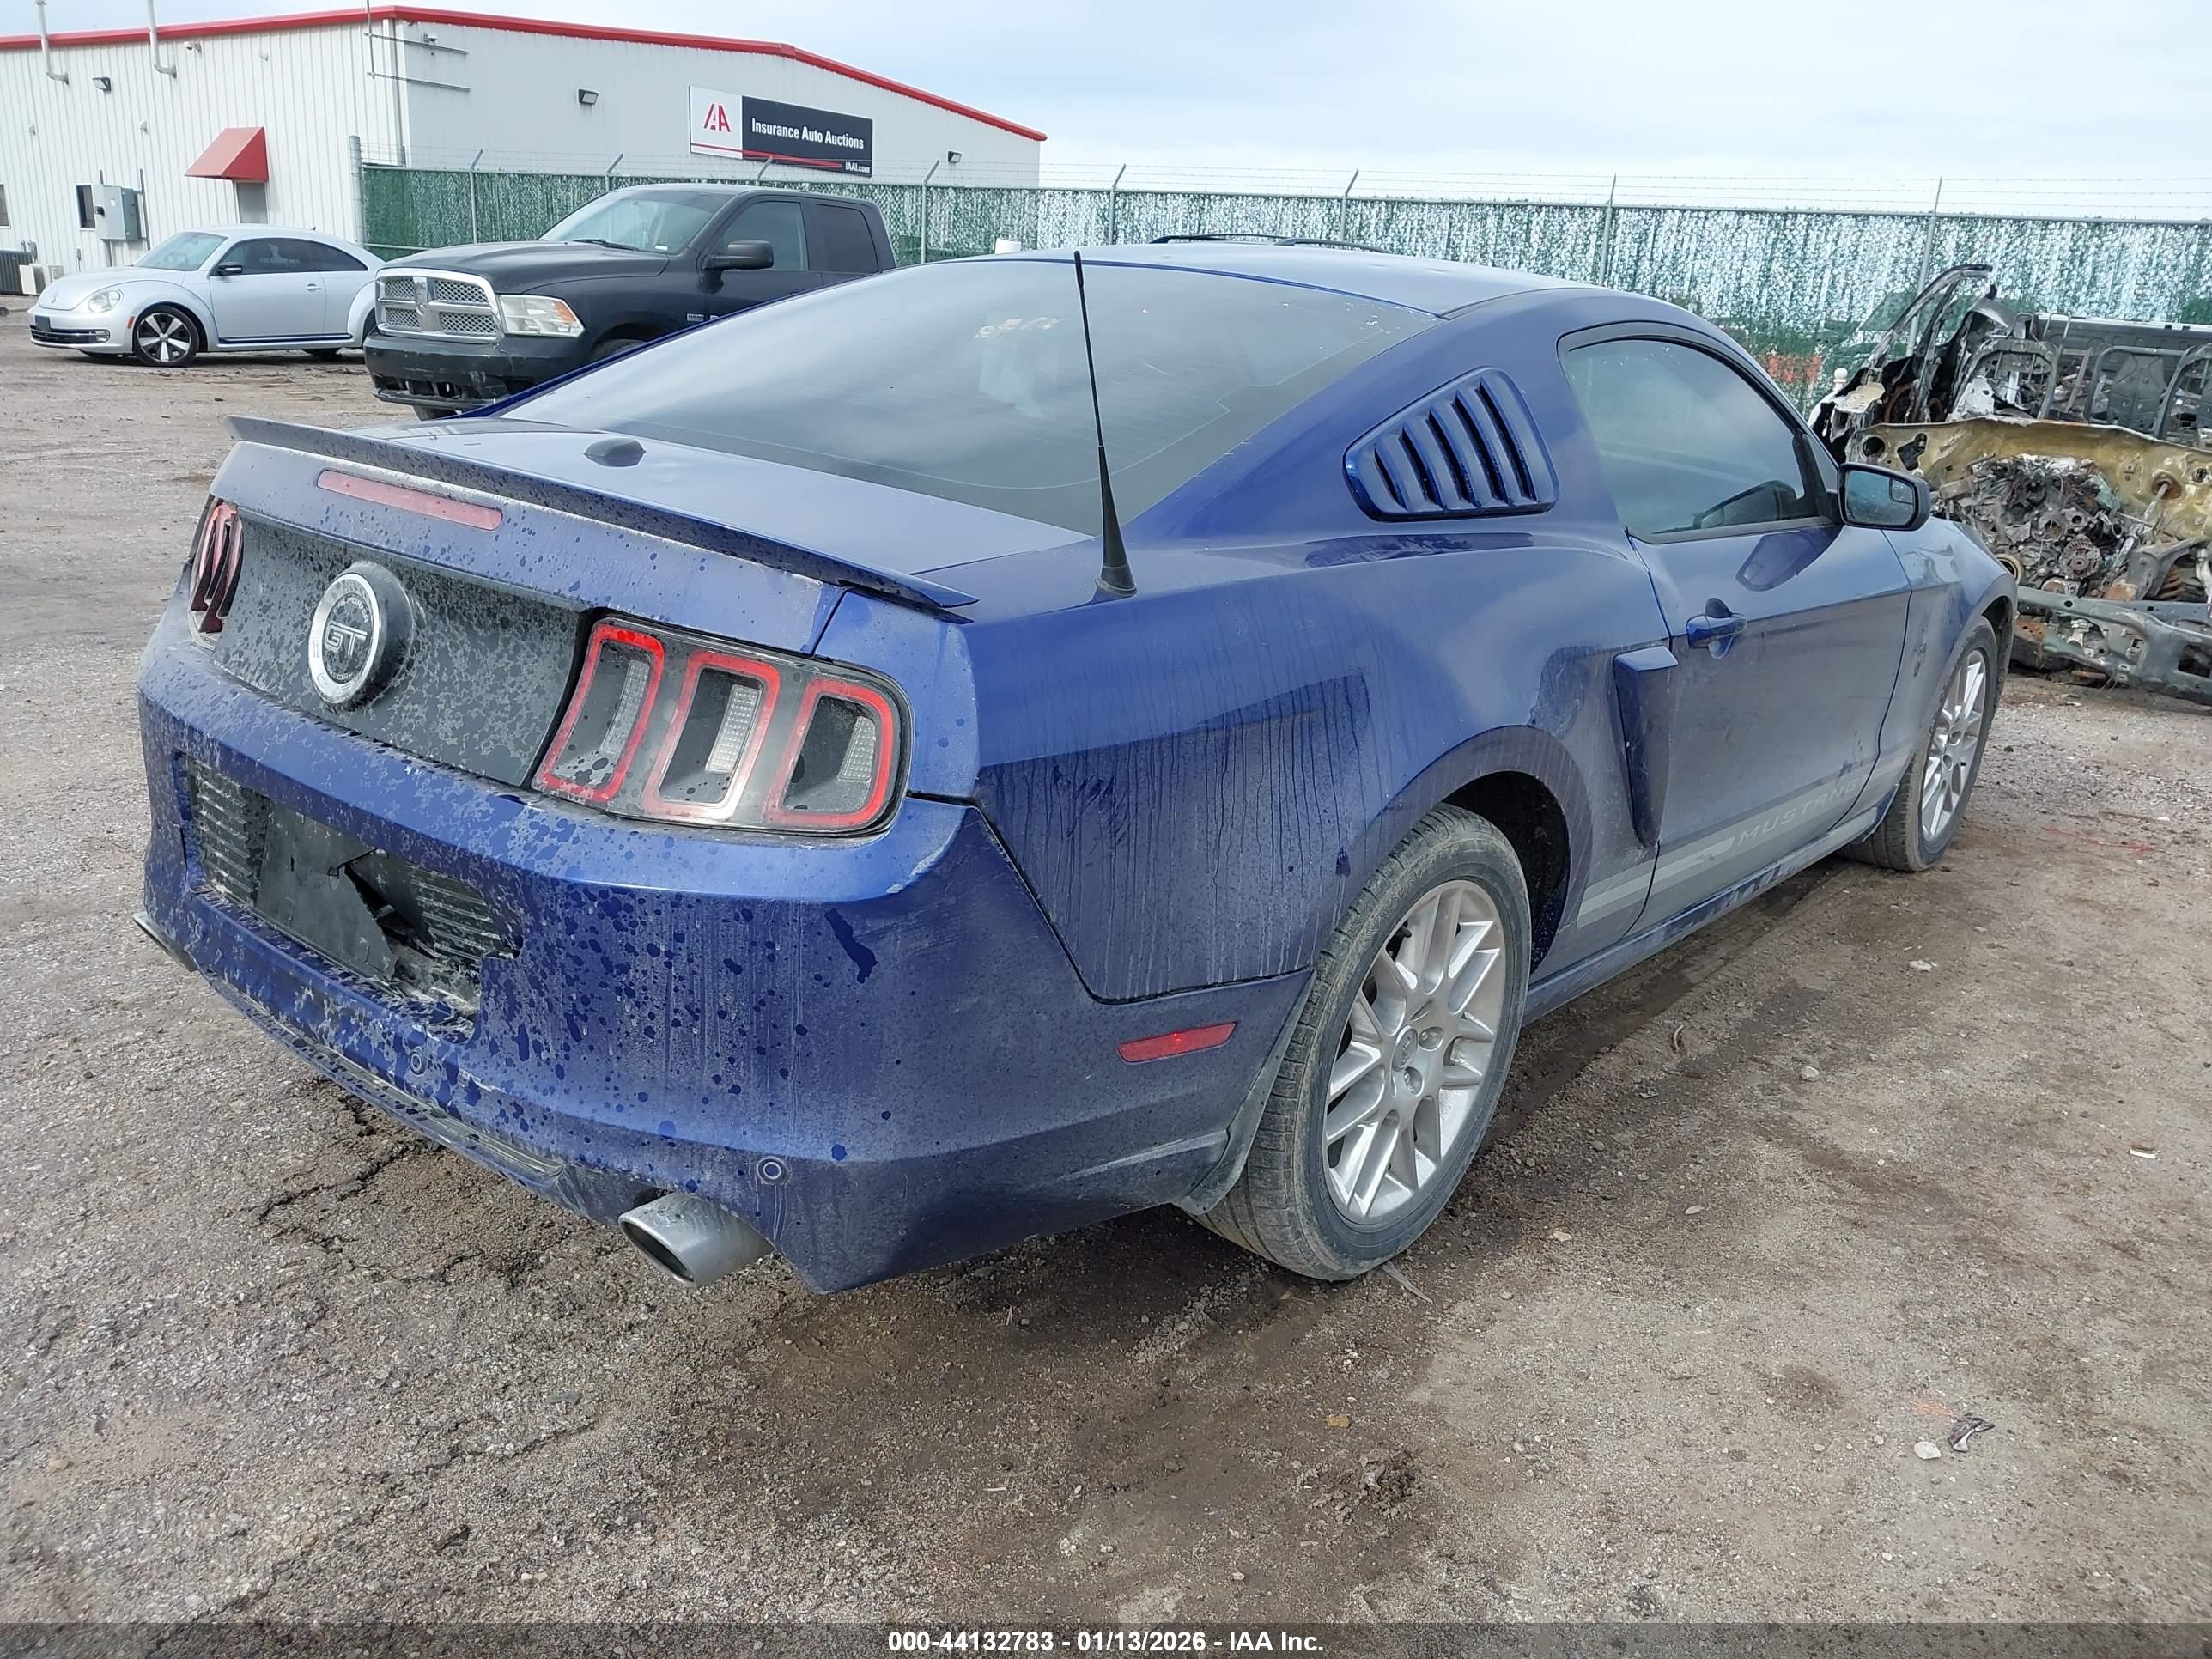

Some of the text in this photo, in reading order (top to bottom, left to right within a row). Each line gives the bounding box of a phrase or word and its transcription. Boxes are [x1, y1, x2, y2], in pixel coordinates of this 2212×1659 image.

[752, 117, 864, 149] Insurance Auto Auctions
[845, 161, 870, 173] IAAI.com
[325, 619, 368, 657] GT
[1738, 778, 1860, 846] MUSTANG
